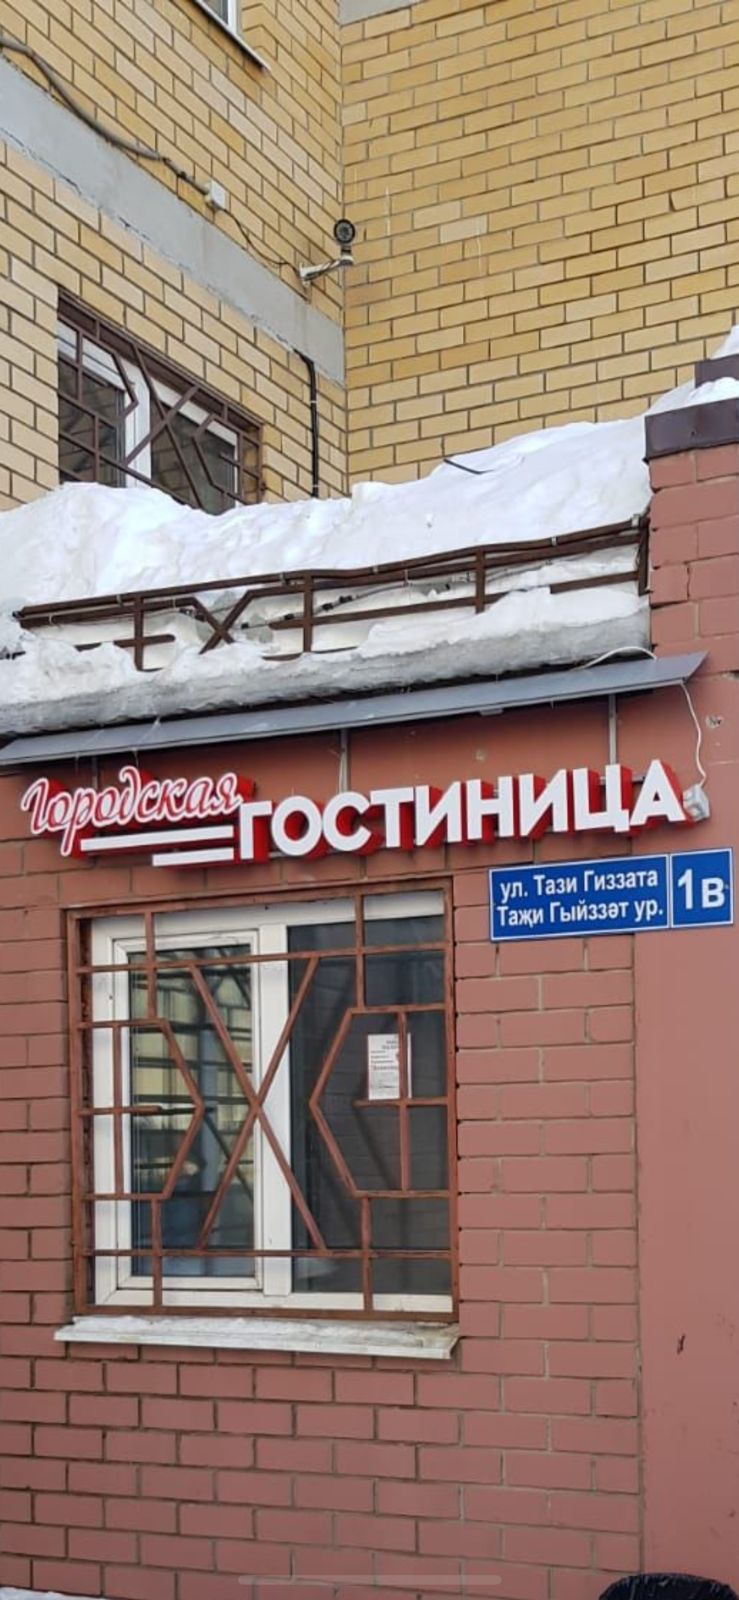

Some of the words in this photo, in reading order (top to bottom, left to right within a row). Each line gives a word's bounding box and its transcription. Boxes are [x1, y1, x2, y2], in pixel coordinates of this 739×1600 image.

[22, 766, 243, 854] Городская
[238, 759, 685, 860] ГОСТИНИЦА
[496, 906, 544, 928] Таҗи
[549, 899, 630, 924] Гыйззәт
[634, 898, 664, 922] ур.
[500, 881, 528, 903] ул.
[533, 874, 577, 896] Тази
[583, 870, 658, 891] Гиззата
